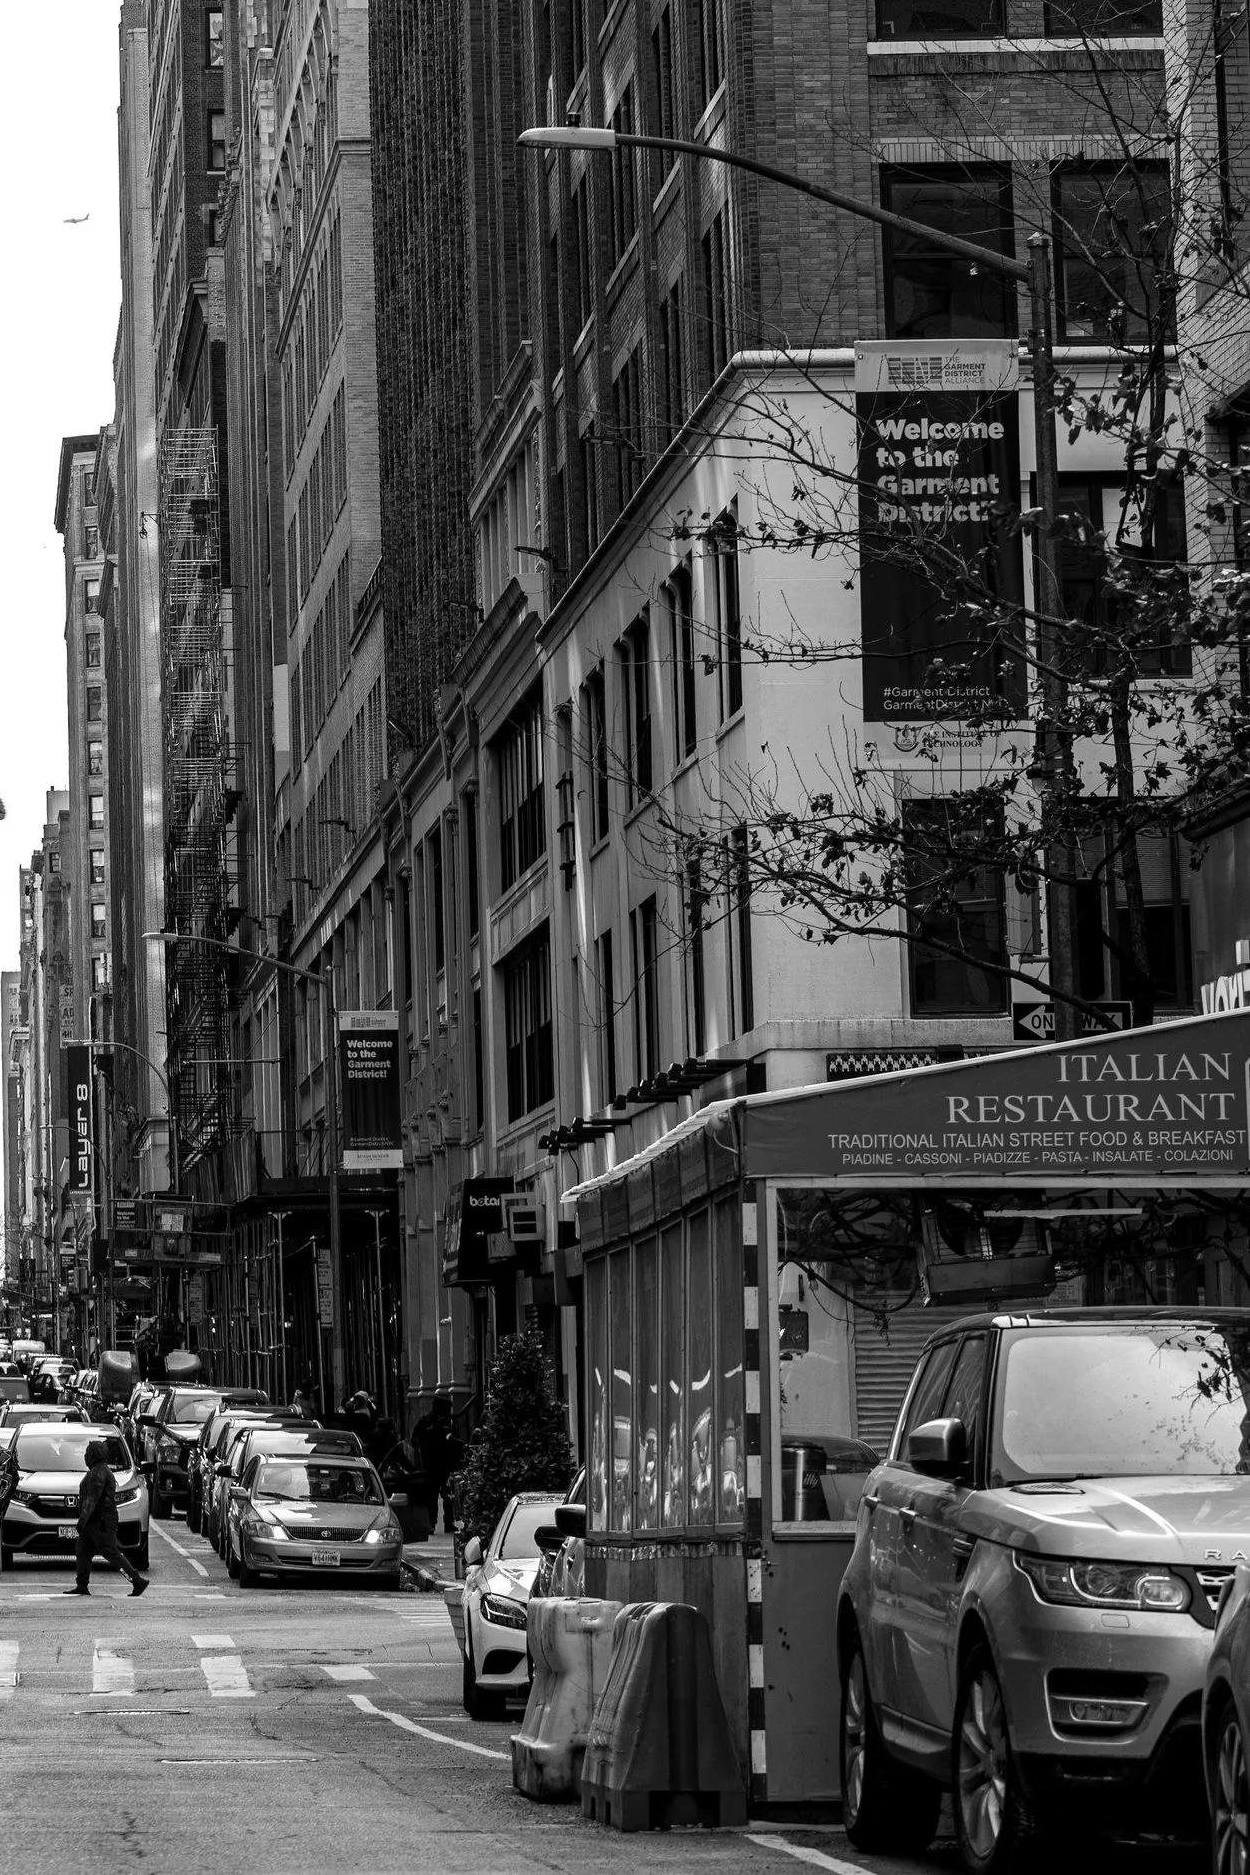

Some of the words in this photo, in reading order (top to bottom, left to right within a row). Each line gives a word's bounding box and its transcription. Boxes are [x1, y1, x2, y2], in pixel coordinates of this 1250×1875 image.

[944, 356, 961, 364] THE
[944, 363, 987, 371] GARMENT
[944, 370, 984, 378] DISTRICT
[944, 377, 986, 385] ALLIANCE
[875, 417, 1005, 441] Welcome
[876, 446, 906, 468] to
[912, 445, 960, 468] the
[877, 473, 1000, 496] Garment
[883, 686, 945, 698] #Garment
[947, 685, 991, 697] District
[1031, 1014, 1055, 1031] ON
[347, 1039, 393, 1049] Welcome
[347, 1049, 358, 1059] to
[360, 1049, 377, 1059] the
[348, 1059, 392, 1069] Garment
[1056, 1052, 1233, 1083] ITALIAN
[348, 1069, 388, 1080] District!
[946, 1092, 1237, 1124] RESTAURANT
[828, 1133, 939, 1150] TRADITIONAL
[943, 1132, 1005, 1148] ITALIAN
[1009, 1131, 1076, 1148] STREET
[1080, 1130, 1129, 1147] FOOD
[1133, 1130, 1144, 1147] &
[1149, 1129, 1247, 1146] BREAKFAST
[842, 1152, 894, 1166] PIADINE
[904, 1151, 962, 1165] CASSONI
[973, 1151, 1031, 1164] PIADIZZE
[1042, 1151, 1082, 1163] PASTA
[1092, 1150, 1154, 1163] INSALATE
[1164, 1149, 1234, 1162] COLAZIONI
[803, 1472, 819, 1489] illy
